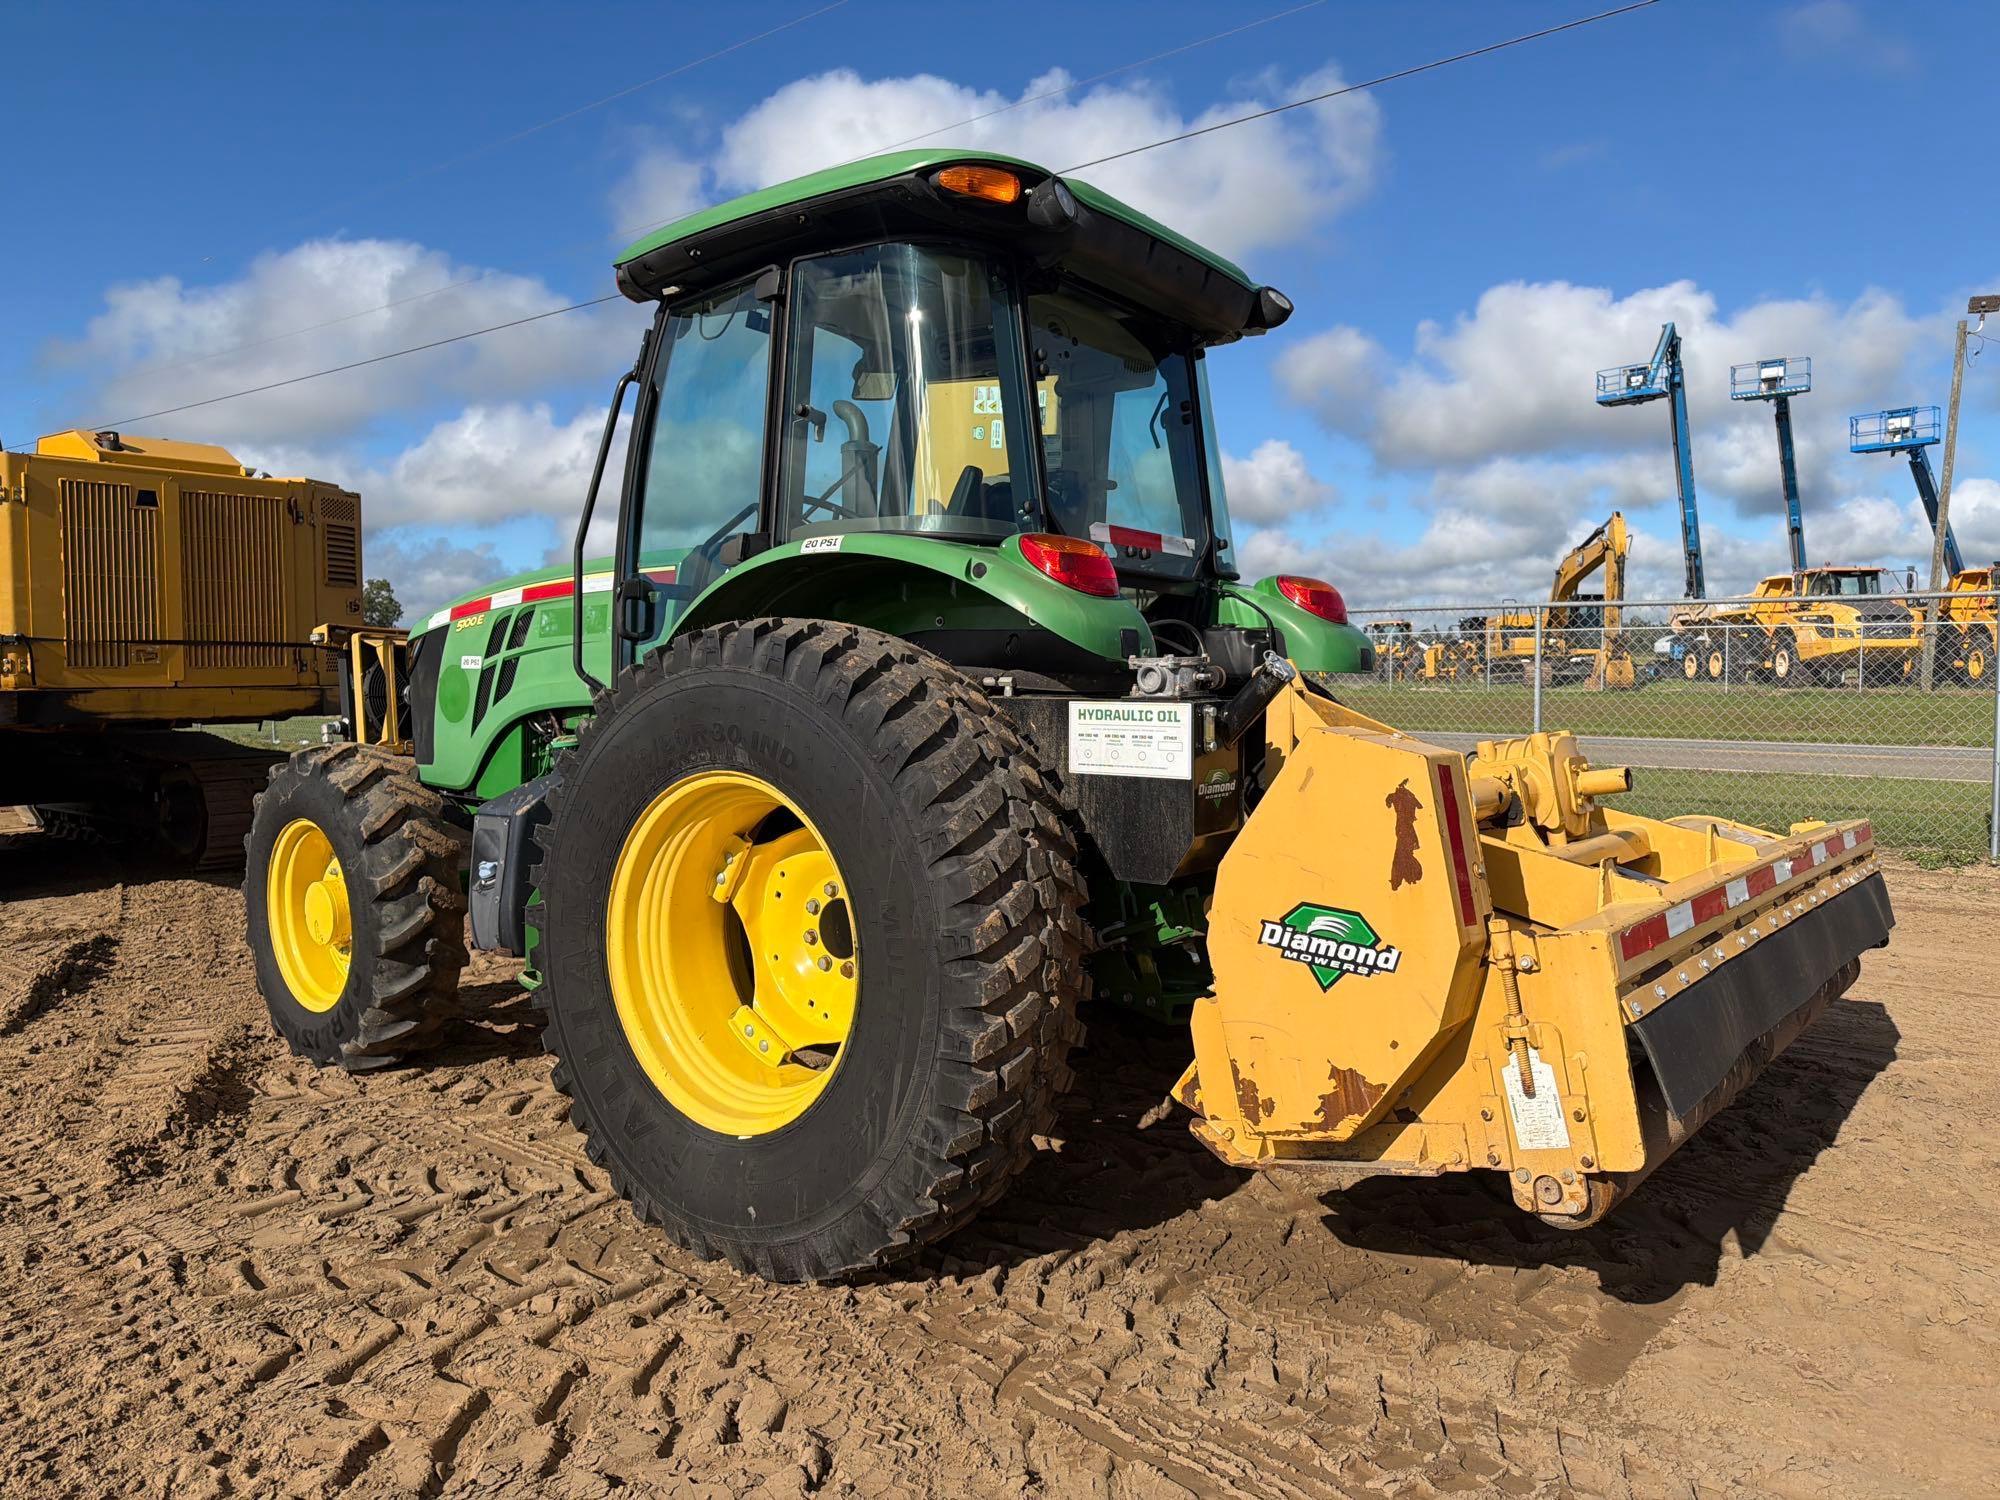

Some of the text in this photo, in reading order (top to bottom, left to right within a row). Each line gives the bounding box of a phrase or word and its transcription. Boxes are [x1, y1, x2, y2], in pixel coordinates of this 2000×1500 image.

[805, 538, 838, 548] 20 PSI
[1078, 708, 1181, 723] HYDRAULIC OIL
[1198, 779, 1236, 796] Diamond
[1260, 922, 1402, 971] Diamond
[1283, 950, 1370, 975] MOWERS
